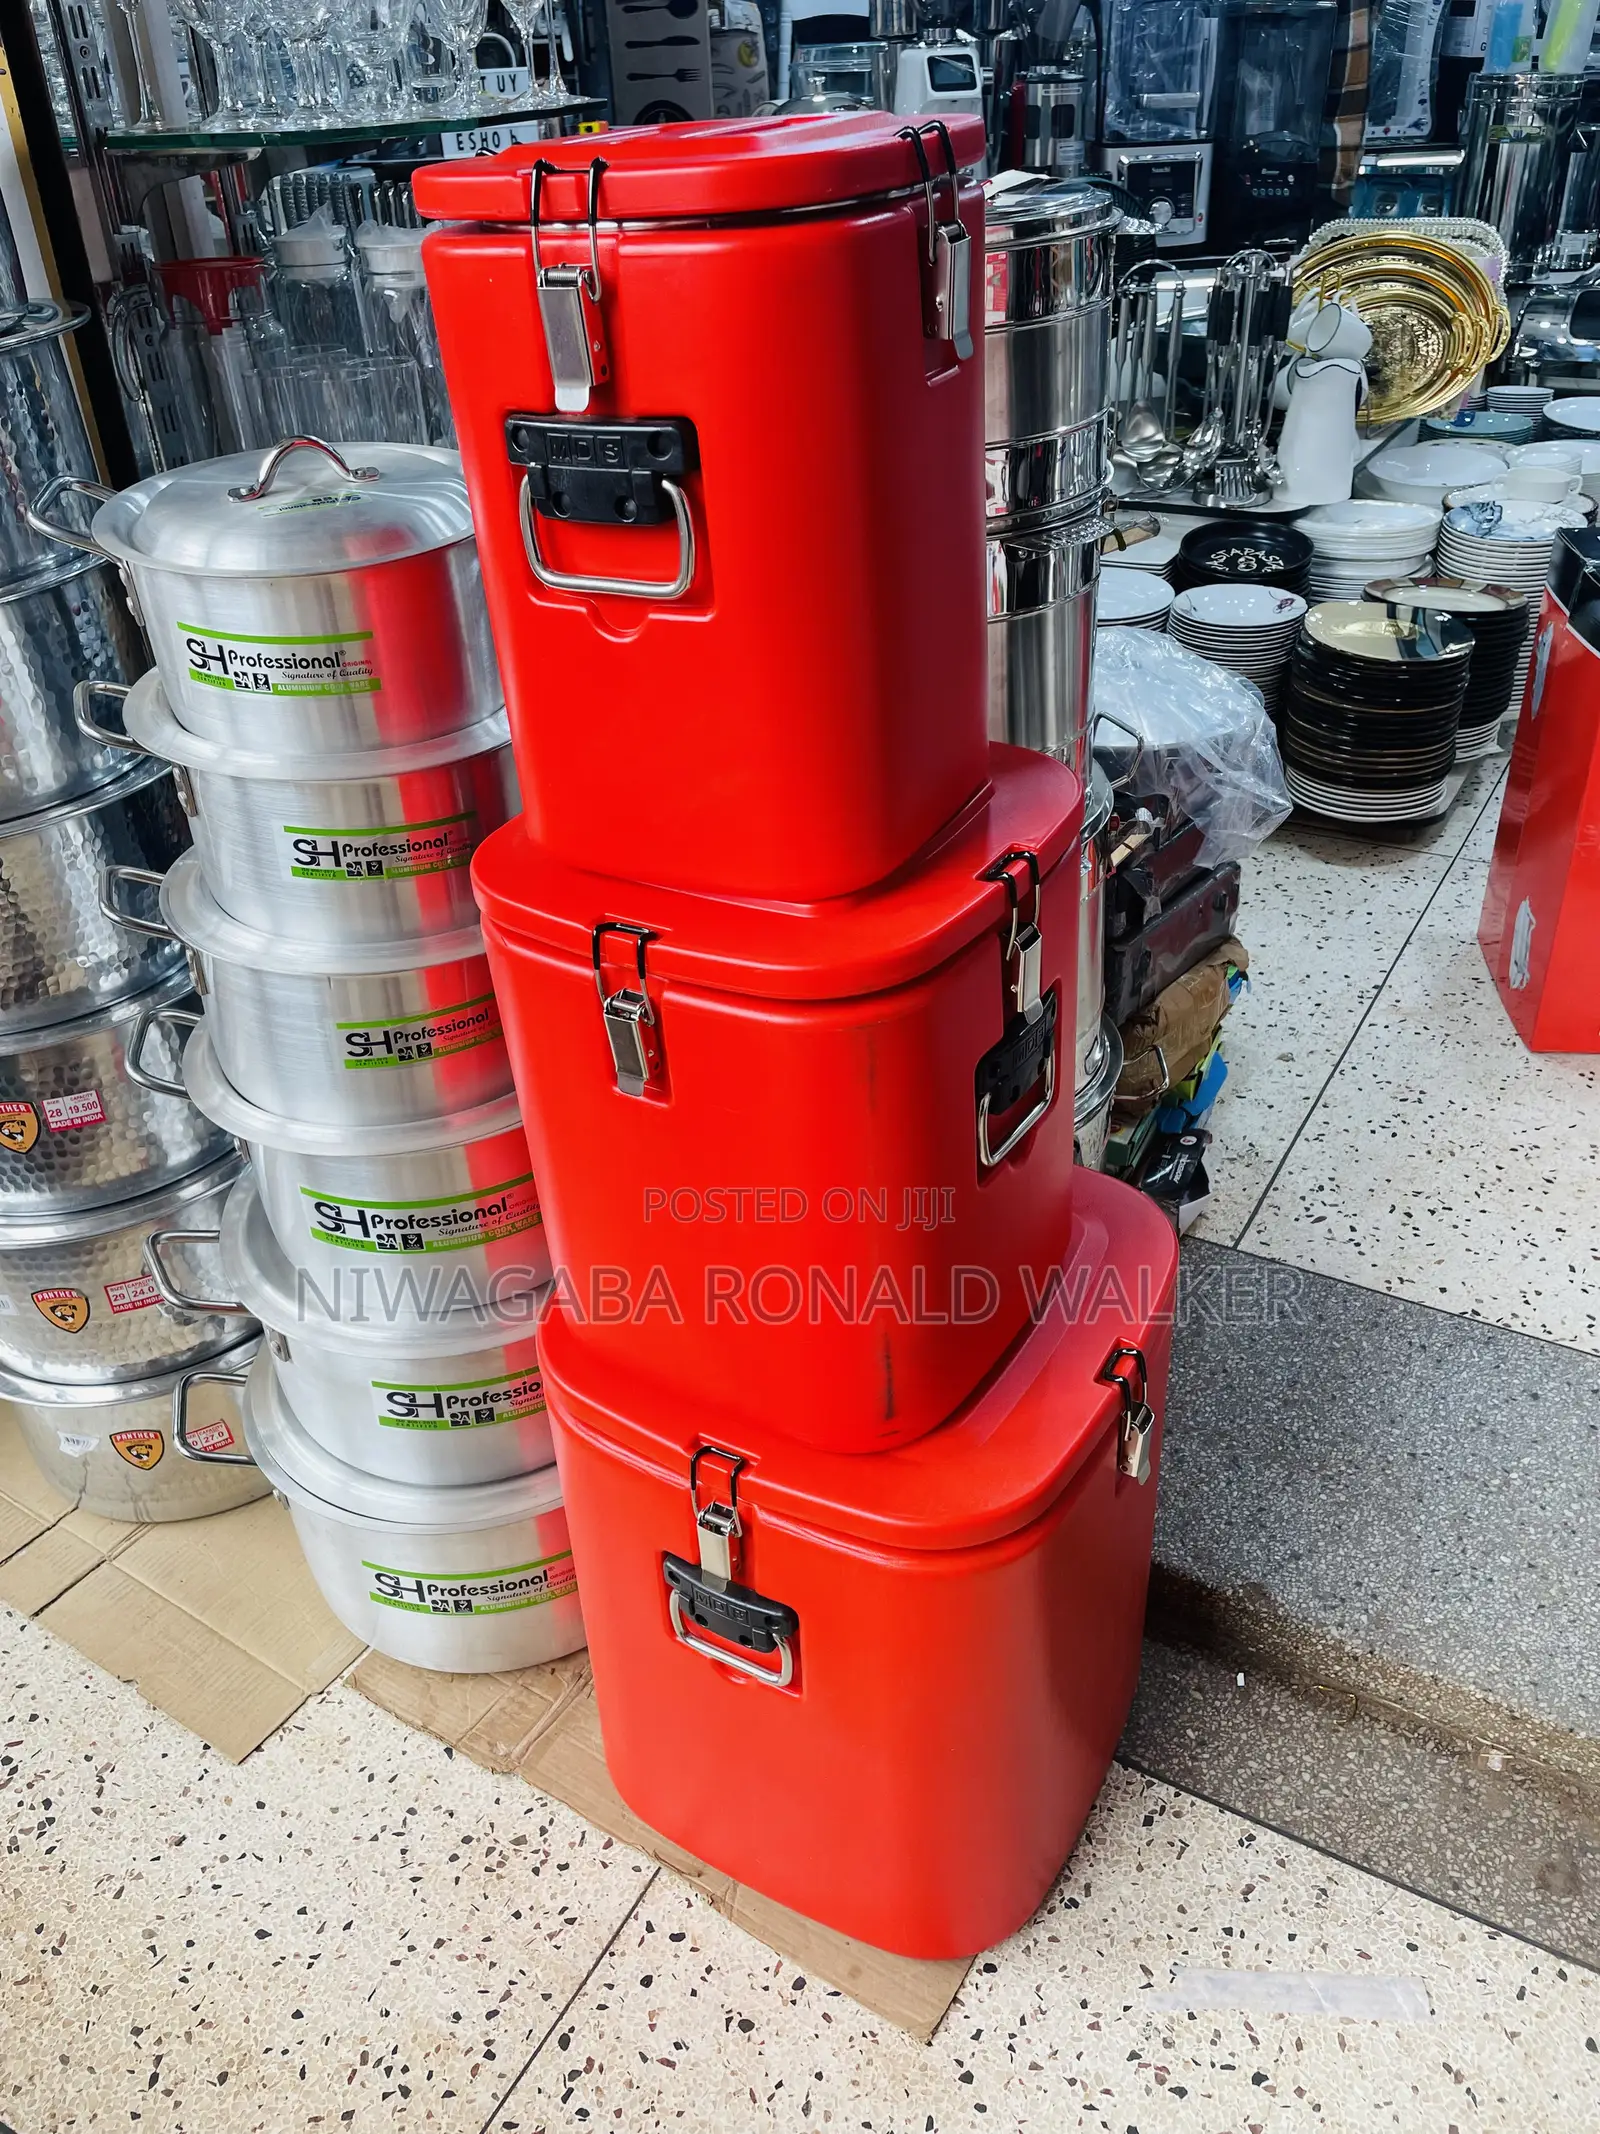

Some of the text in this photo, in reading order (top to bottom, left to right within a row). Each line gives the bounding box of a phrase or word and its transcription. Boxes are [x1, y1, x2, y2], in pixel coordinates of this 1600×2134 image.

[186, 637, 229, 675] SH
[281, 667, 373, 681] Signature of Quality
[293, 838, 341, 867] SH
[345, 1030, 393, 1057] SH
[0, 1104, 26, 1113] THER
[48, 1108, 63, 1118] 28
[68, 1101, 98, 1114] 19.500
[50, 1120, 72, 1129] MADE
[83, 1113, 103, 1122] INDIA
[314, 1201, 370, 1238] SH
[438, 1222, 488, 1237] Signature
[506, 1203, 541, 1221] Quality
[432, 1231, 486, 1248] ALUMINIUM
[487, 1223, 513, 1237] COOK
[514, 1215, 539, 1230] WARE
[37, 1290, 78, 1302] PANTHER
[131, 1285, 155, 1297] 24.0
[113, 1295, 163, 1312] MADE IN INDIA
[386, 1381, 543, 1418] SH Professio
[115, 1433, 157, 1442] PANTHER
[203, 1431, 225, 1444] 27.0
[216, 1438, 233, 1450] INDIA
[374, 1572, 426, 1602] SH
[485, 1589, 531, 1602] Signature
[533, 1585, 544, 1594] of
[480, 1597, 528, 1611] ALUMINIUM
